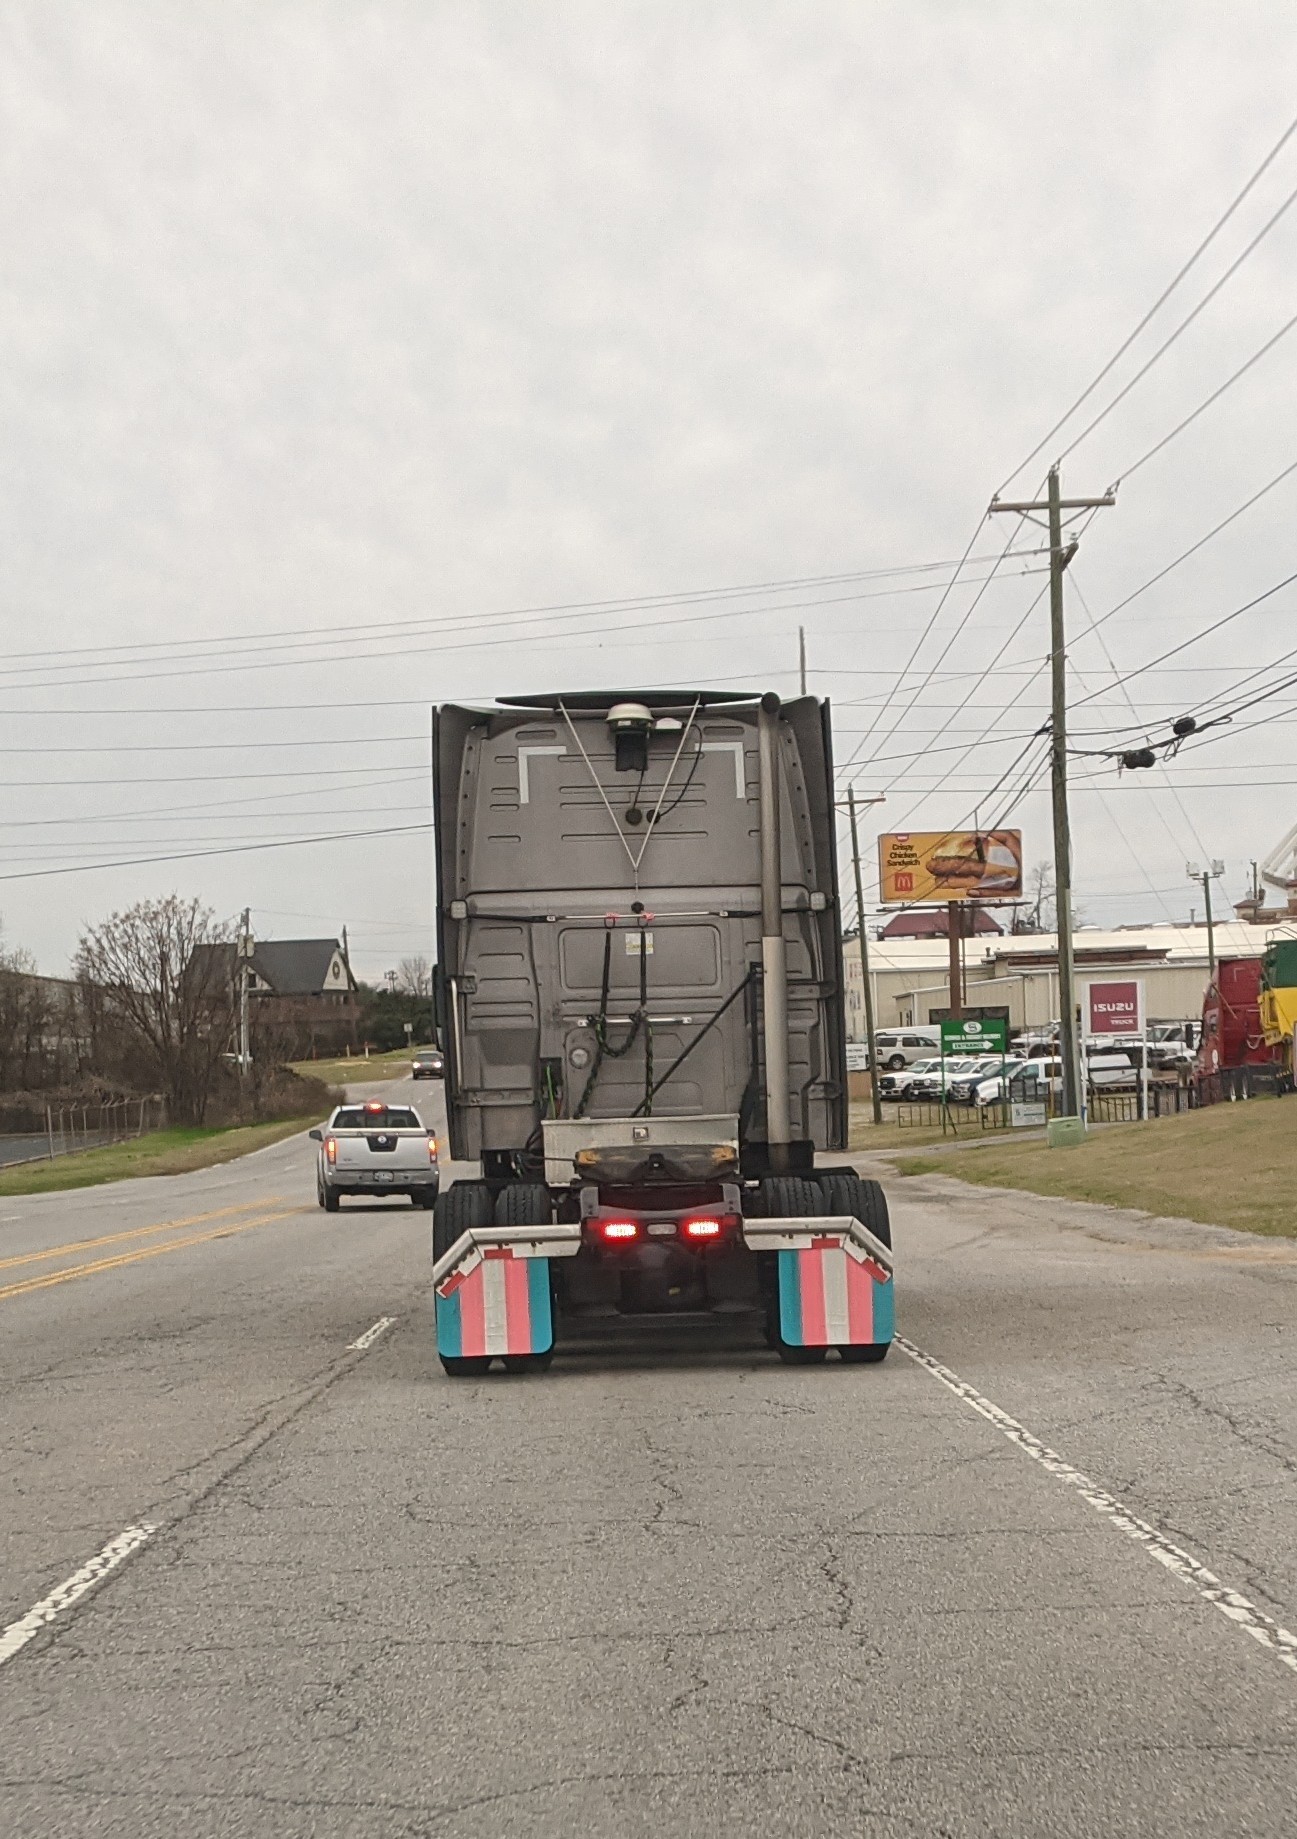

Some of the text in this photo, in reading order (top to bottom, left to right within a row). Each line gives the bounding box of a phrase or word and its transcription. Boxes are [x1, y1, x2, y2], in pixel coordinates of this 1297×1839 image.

[892, 843, 914, 851] Crispy
[889, 851, 918, 859] Chicken
[886, 859, 921, 867] Sandwich
[1093, 1002, 1134, 1012] ISUZU
